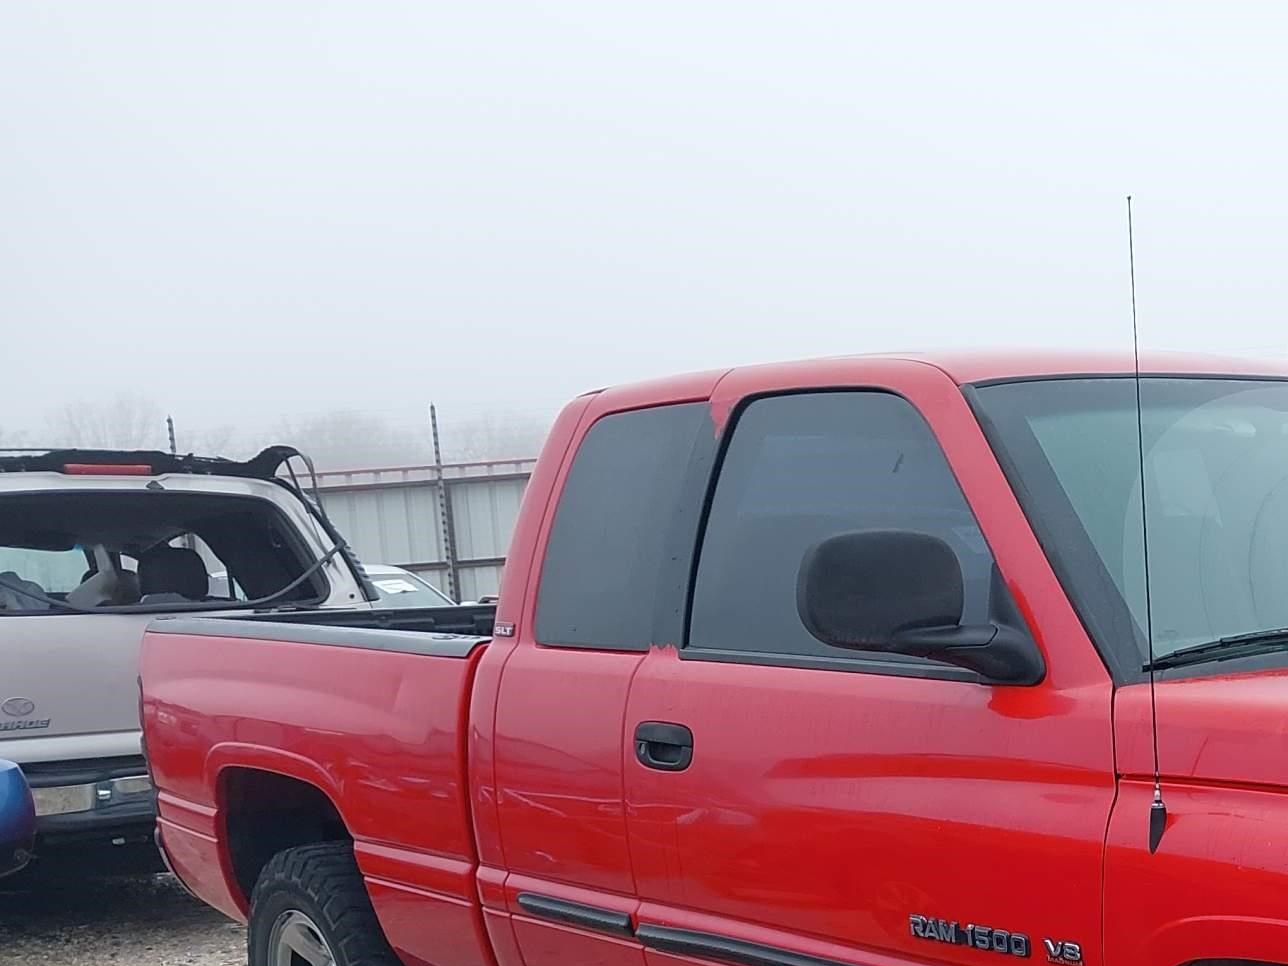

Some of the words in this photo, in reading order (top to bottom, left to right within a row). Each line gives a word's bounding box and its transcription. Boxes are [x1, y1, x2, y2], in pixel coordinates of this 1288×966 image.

[495, 626, 513, 636] SLT
[909, 914, 957, 944] RAM
[965, 923, 1029, 957] 1500
[1043, 938, 1082, 961] V8
